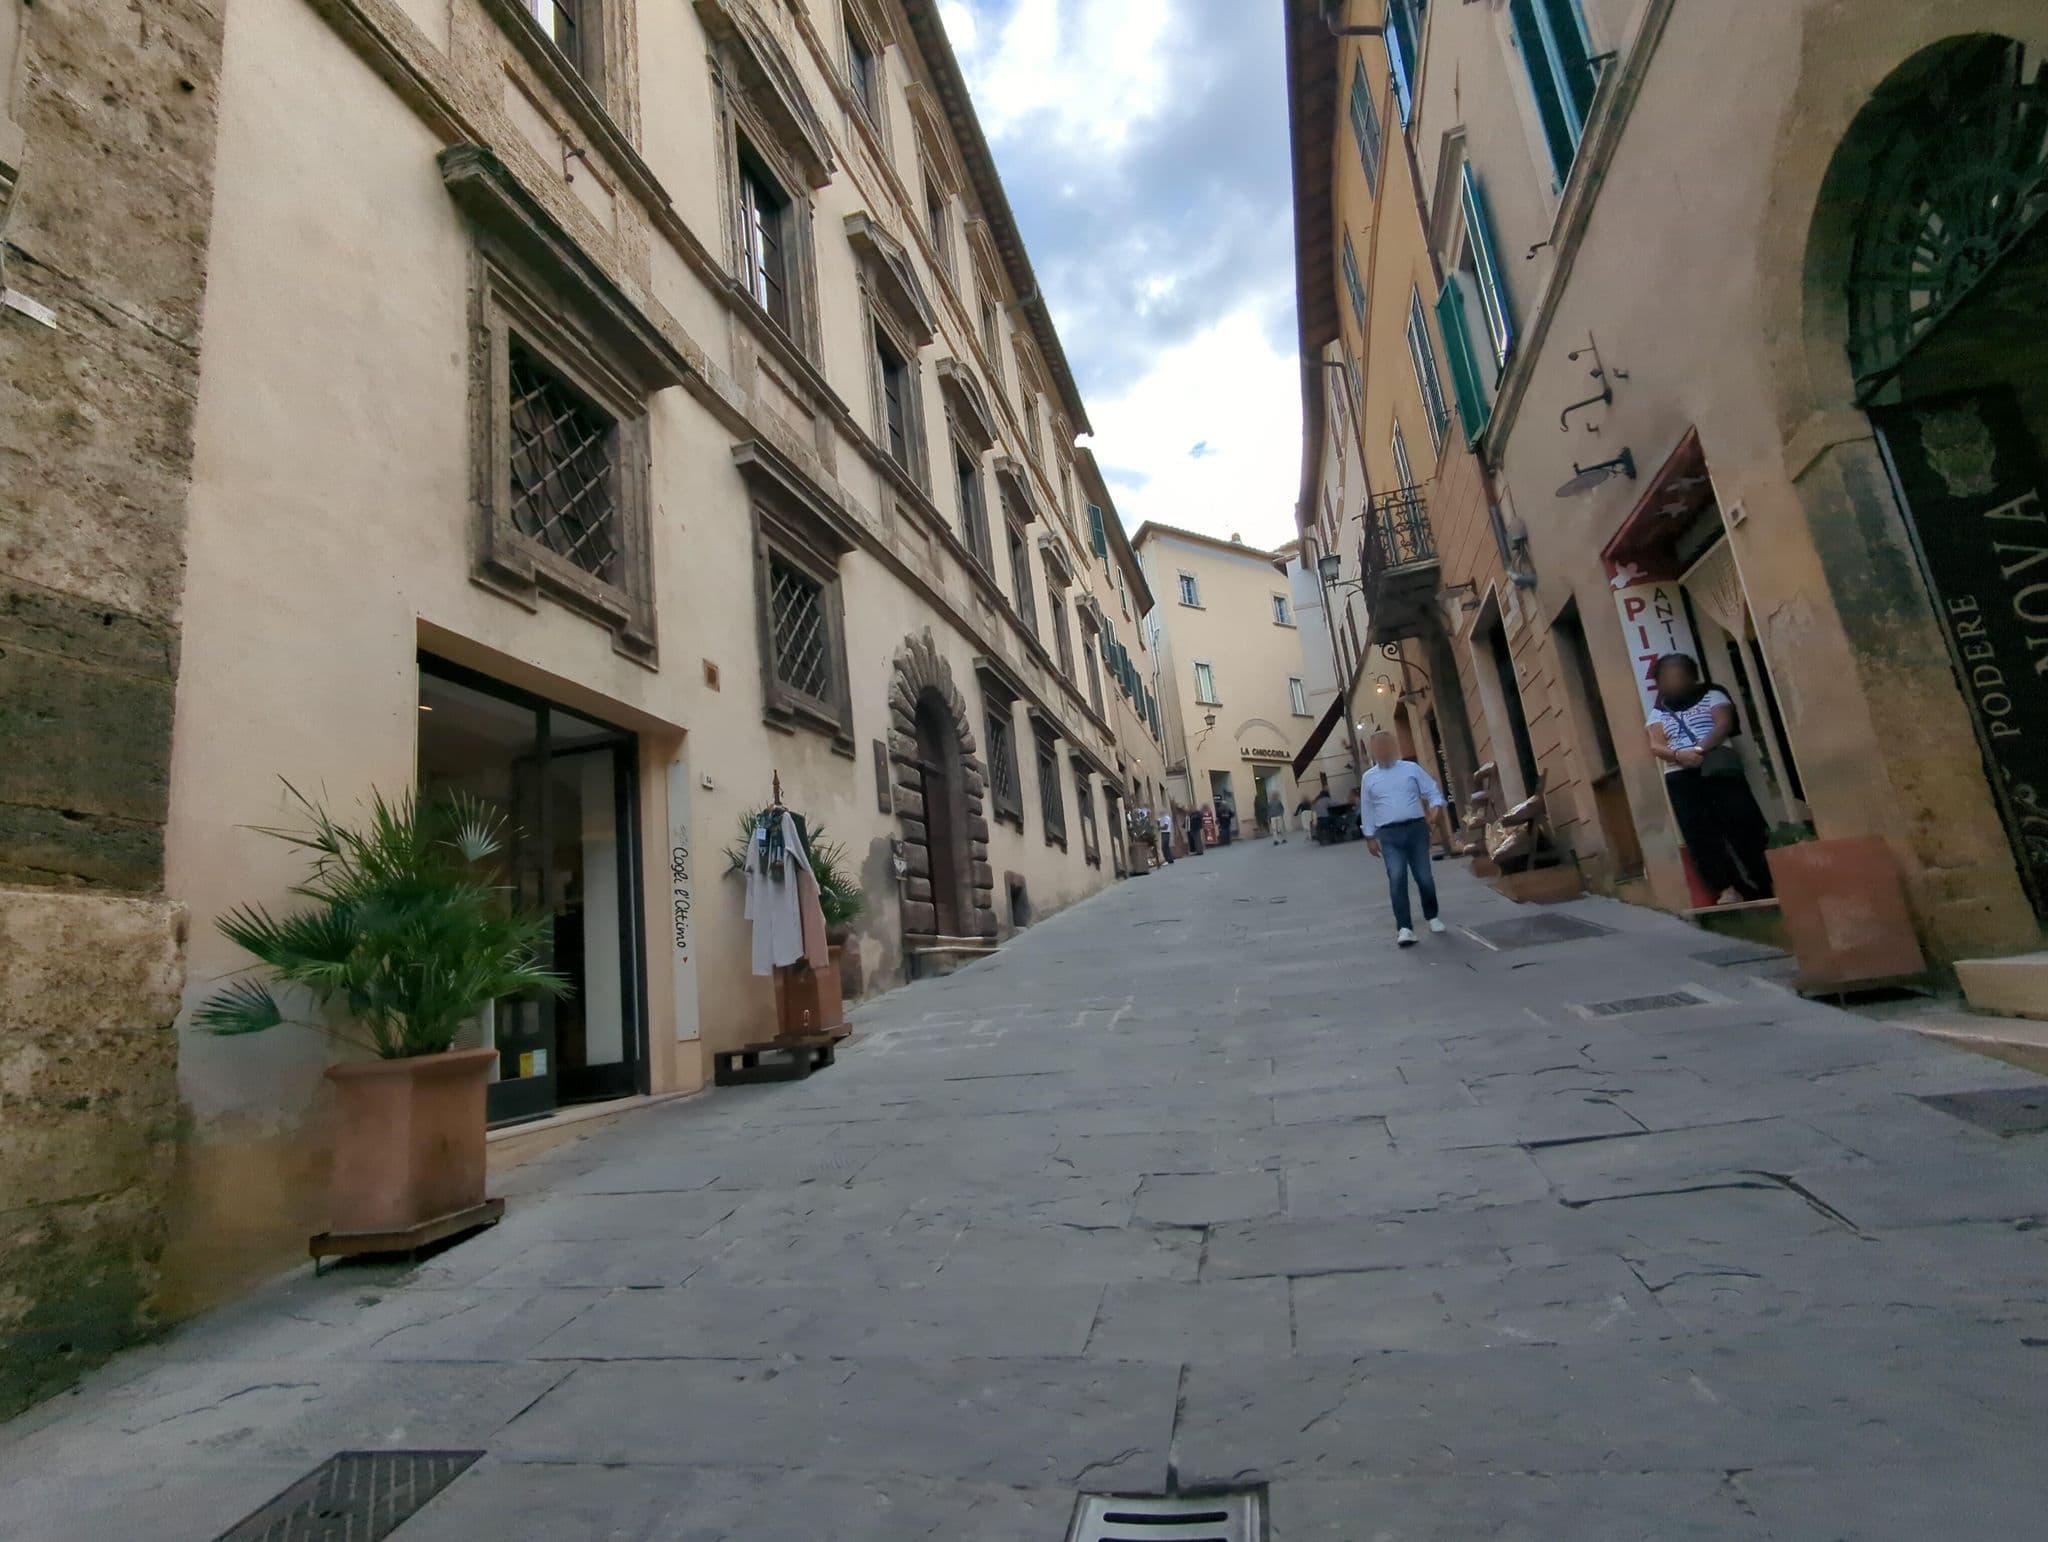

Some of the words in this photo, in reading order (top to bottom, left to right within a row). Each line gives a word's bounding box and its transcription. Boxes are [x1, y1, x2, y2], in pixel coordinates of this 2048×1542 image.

[1948, 593, 2022, 738] PODERE
[1240, 747, 1249, 756] LA
[671, 847, 688, 884] Cogli
